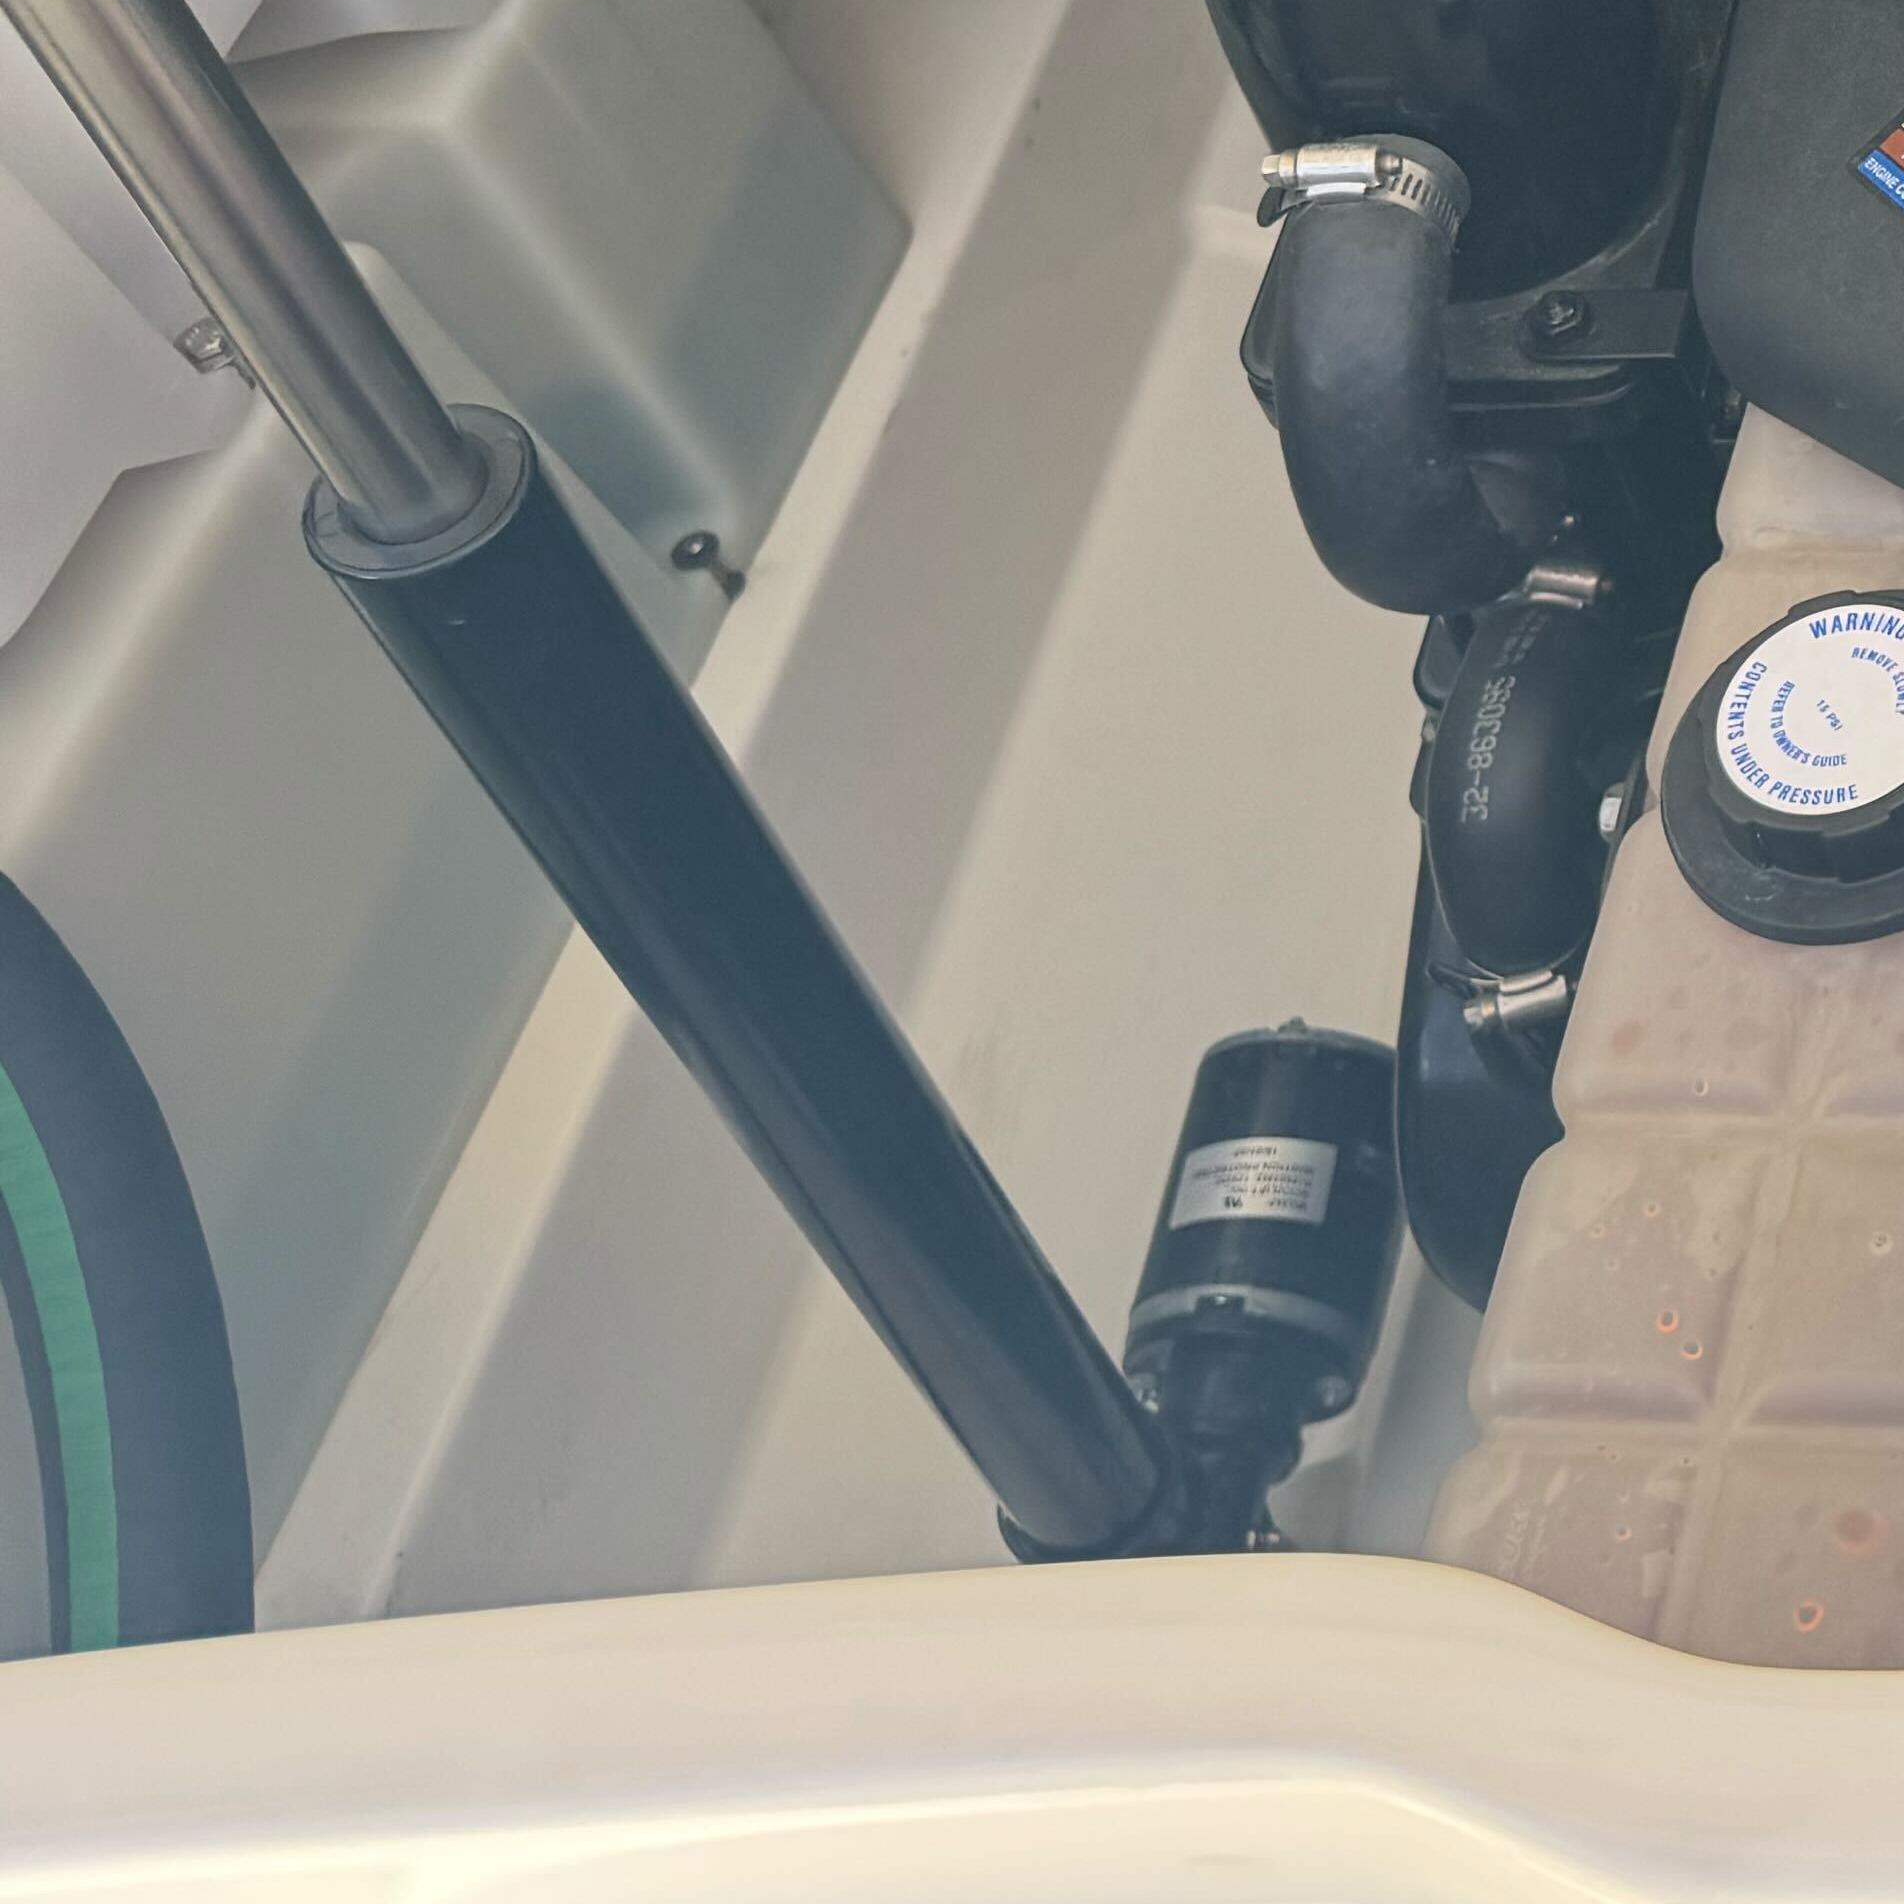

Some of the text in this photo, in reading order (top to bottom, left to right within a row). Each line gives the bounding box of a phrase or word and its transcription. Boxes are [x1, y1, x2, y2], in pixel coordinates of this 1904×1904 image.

[1864, 158, 1899, 189] ENGINE
[1851, 646, 1899, 672] REMOVE
[1727, 661, 1859, 806] CONTENTS UNDER PRESSURE
[1769, 680, 1847, 768] REFER TO OWNER'S GUIDE
[1825, 712, 1844, 732] PSI
